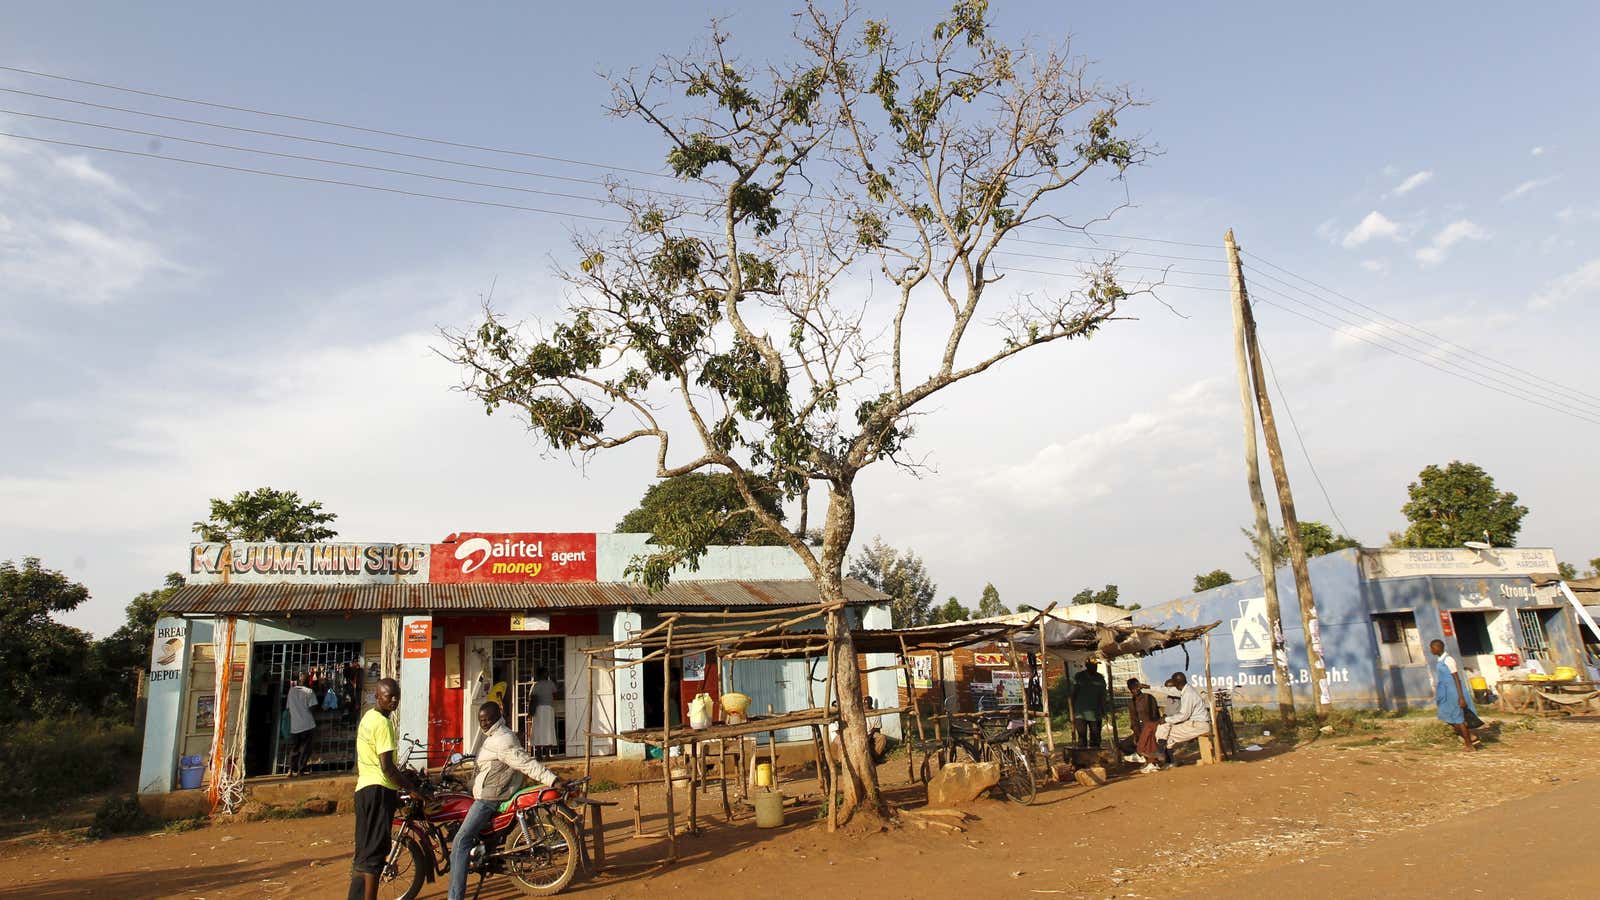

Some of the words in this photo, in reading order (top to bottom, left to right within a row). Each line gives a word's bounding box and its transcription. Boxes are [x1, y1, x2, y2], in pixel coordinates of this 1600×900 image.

[493, 540, 544, 558] airtel
[191, 545, 308, 575] KAJUMA
[311, 545, 362, 574] MINI
[364, 544, 428, 575] SHOP
[552, 552, 586, 566] agent
[492, 562, 542, 577] money
[158, 628, 187, 638] BREAD
[151, 670, 180, 681] DEPOT
